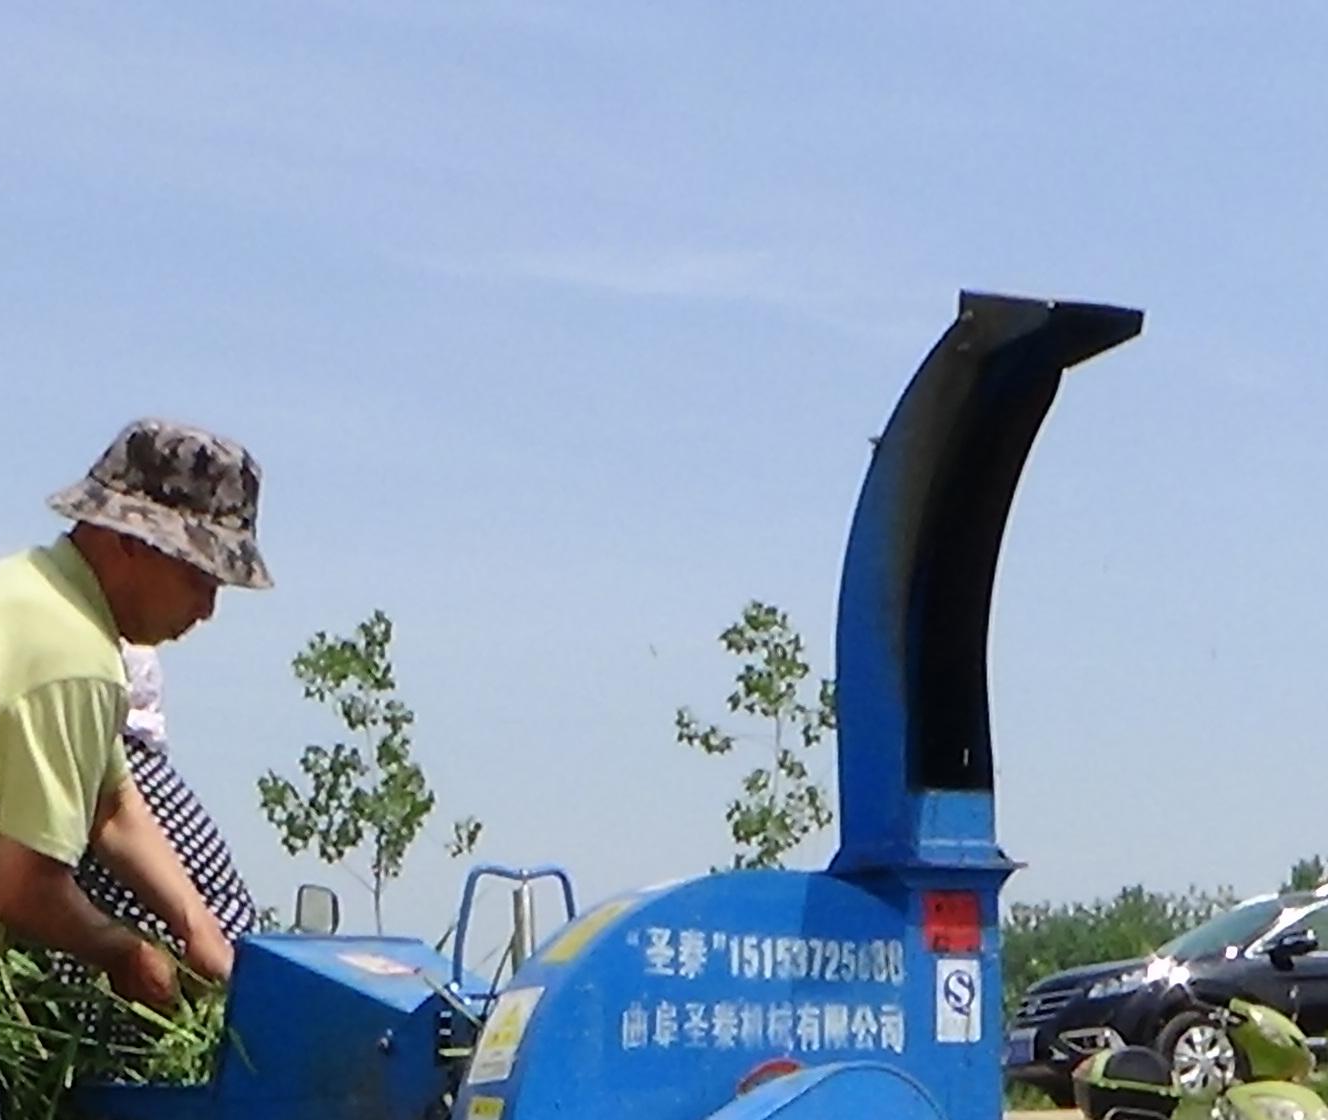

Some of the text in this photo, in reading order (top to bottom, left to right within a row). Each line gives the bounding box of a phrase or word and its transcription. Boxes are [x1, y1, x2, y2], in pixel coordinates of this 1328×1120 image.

[622, 999, 905, 1054] 曲阜圣泰机械有限公司
